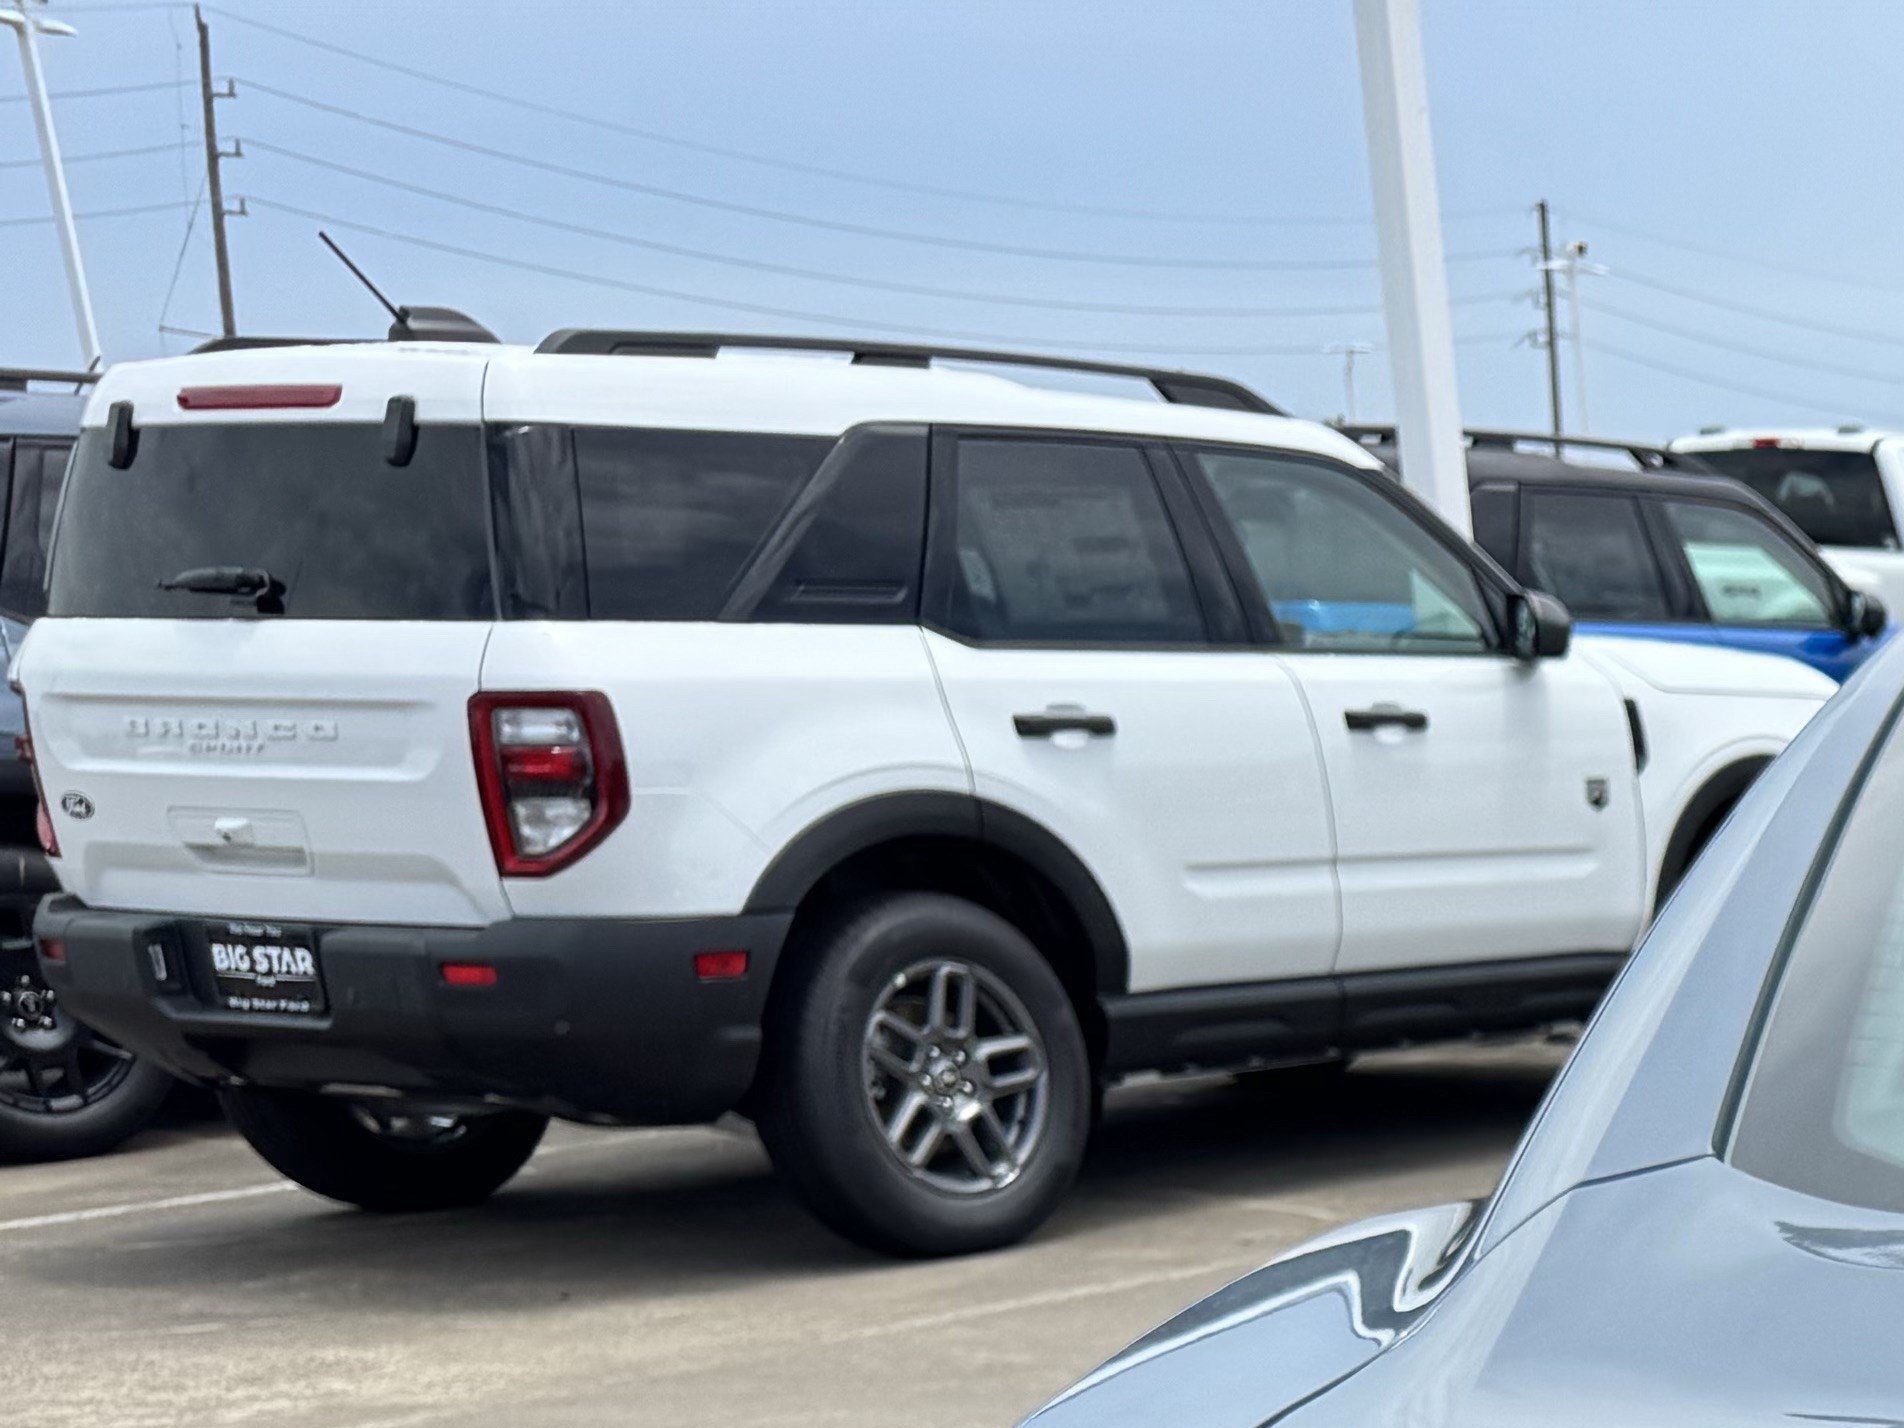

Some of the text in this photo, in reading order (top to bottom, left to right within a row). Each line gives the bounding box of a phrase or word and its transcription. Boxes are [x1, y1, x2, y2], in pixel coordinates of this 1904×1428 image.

[124, 717, 339, 742] BRONCO
[211, 943, 316, 976] BIG STAR
